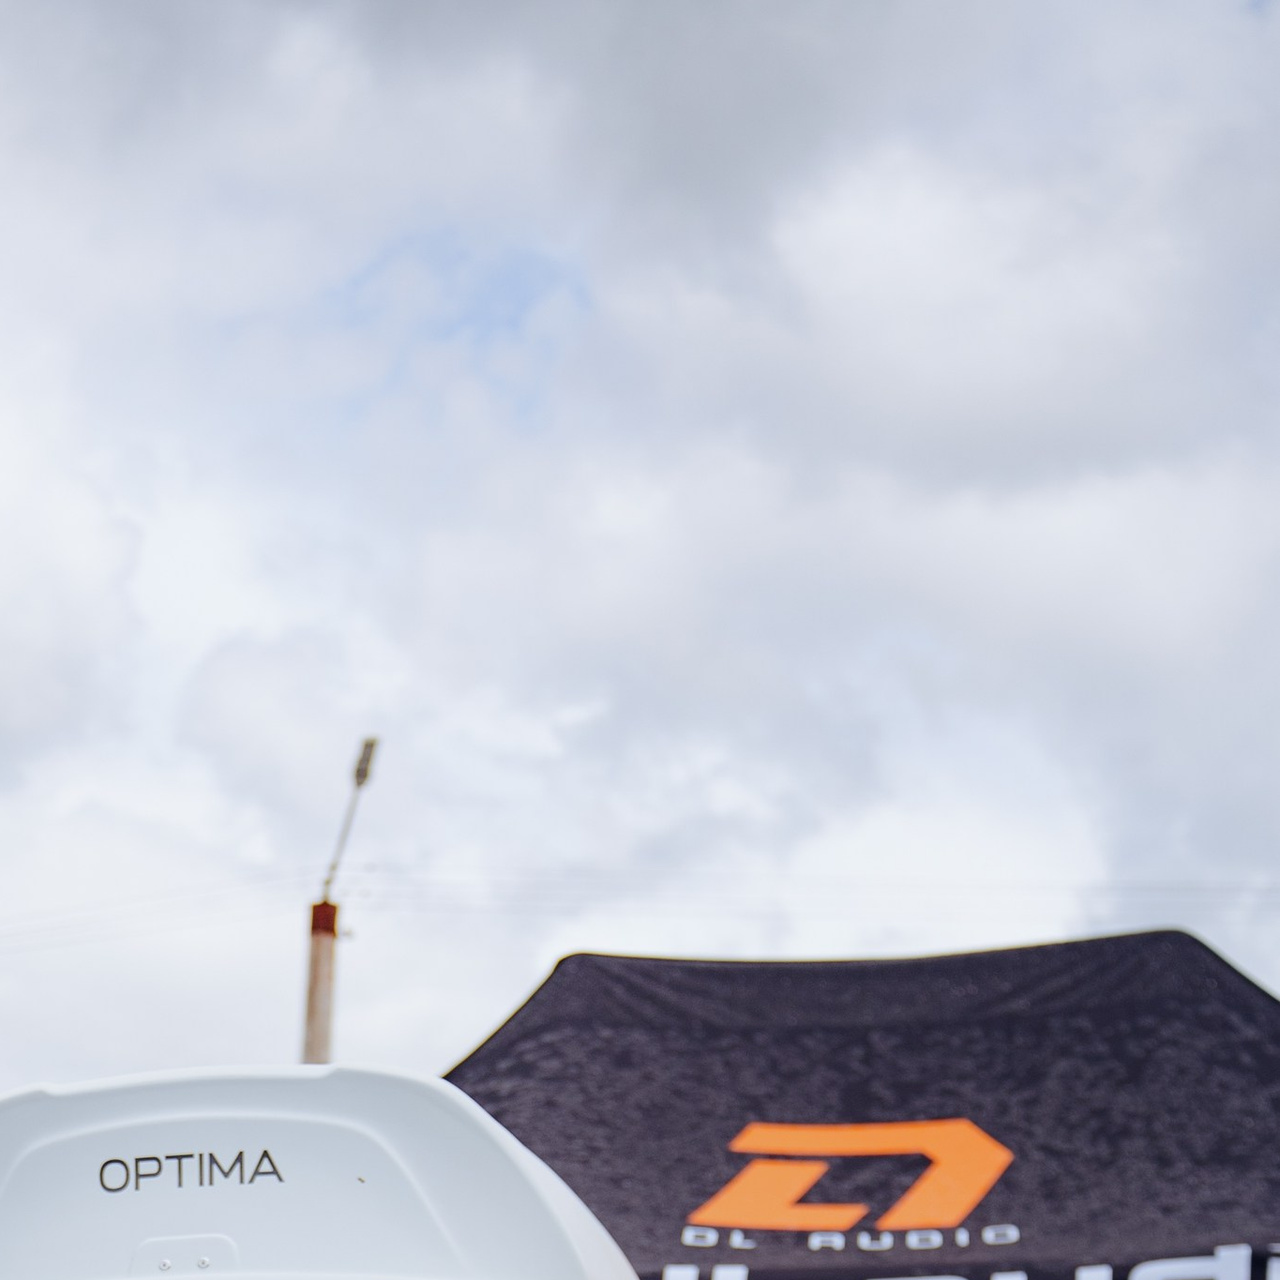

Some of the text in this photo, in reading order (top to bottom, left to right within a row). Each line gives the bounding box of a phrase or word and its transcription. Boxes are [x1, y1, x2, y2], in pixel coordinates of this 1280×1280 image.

[99, 1150, 285, 1192] OPTIMA
[681, 1223, 1020, 1251] DL AUDIO
